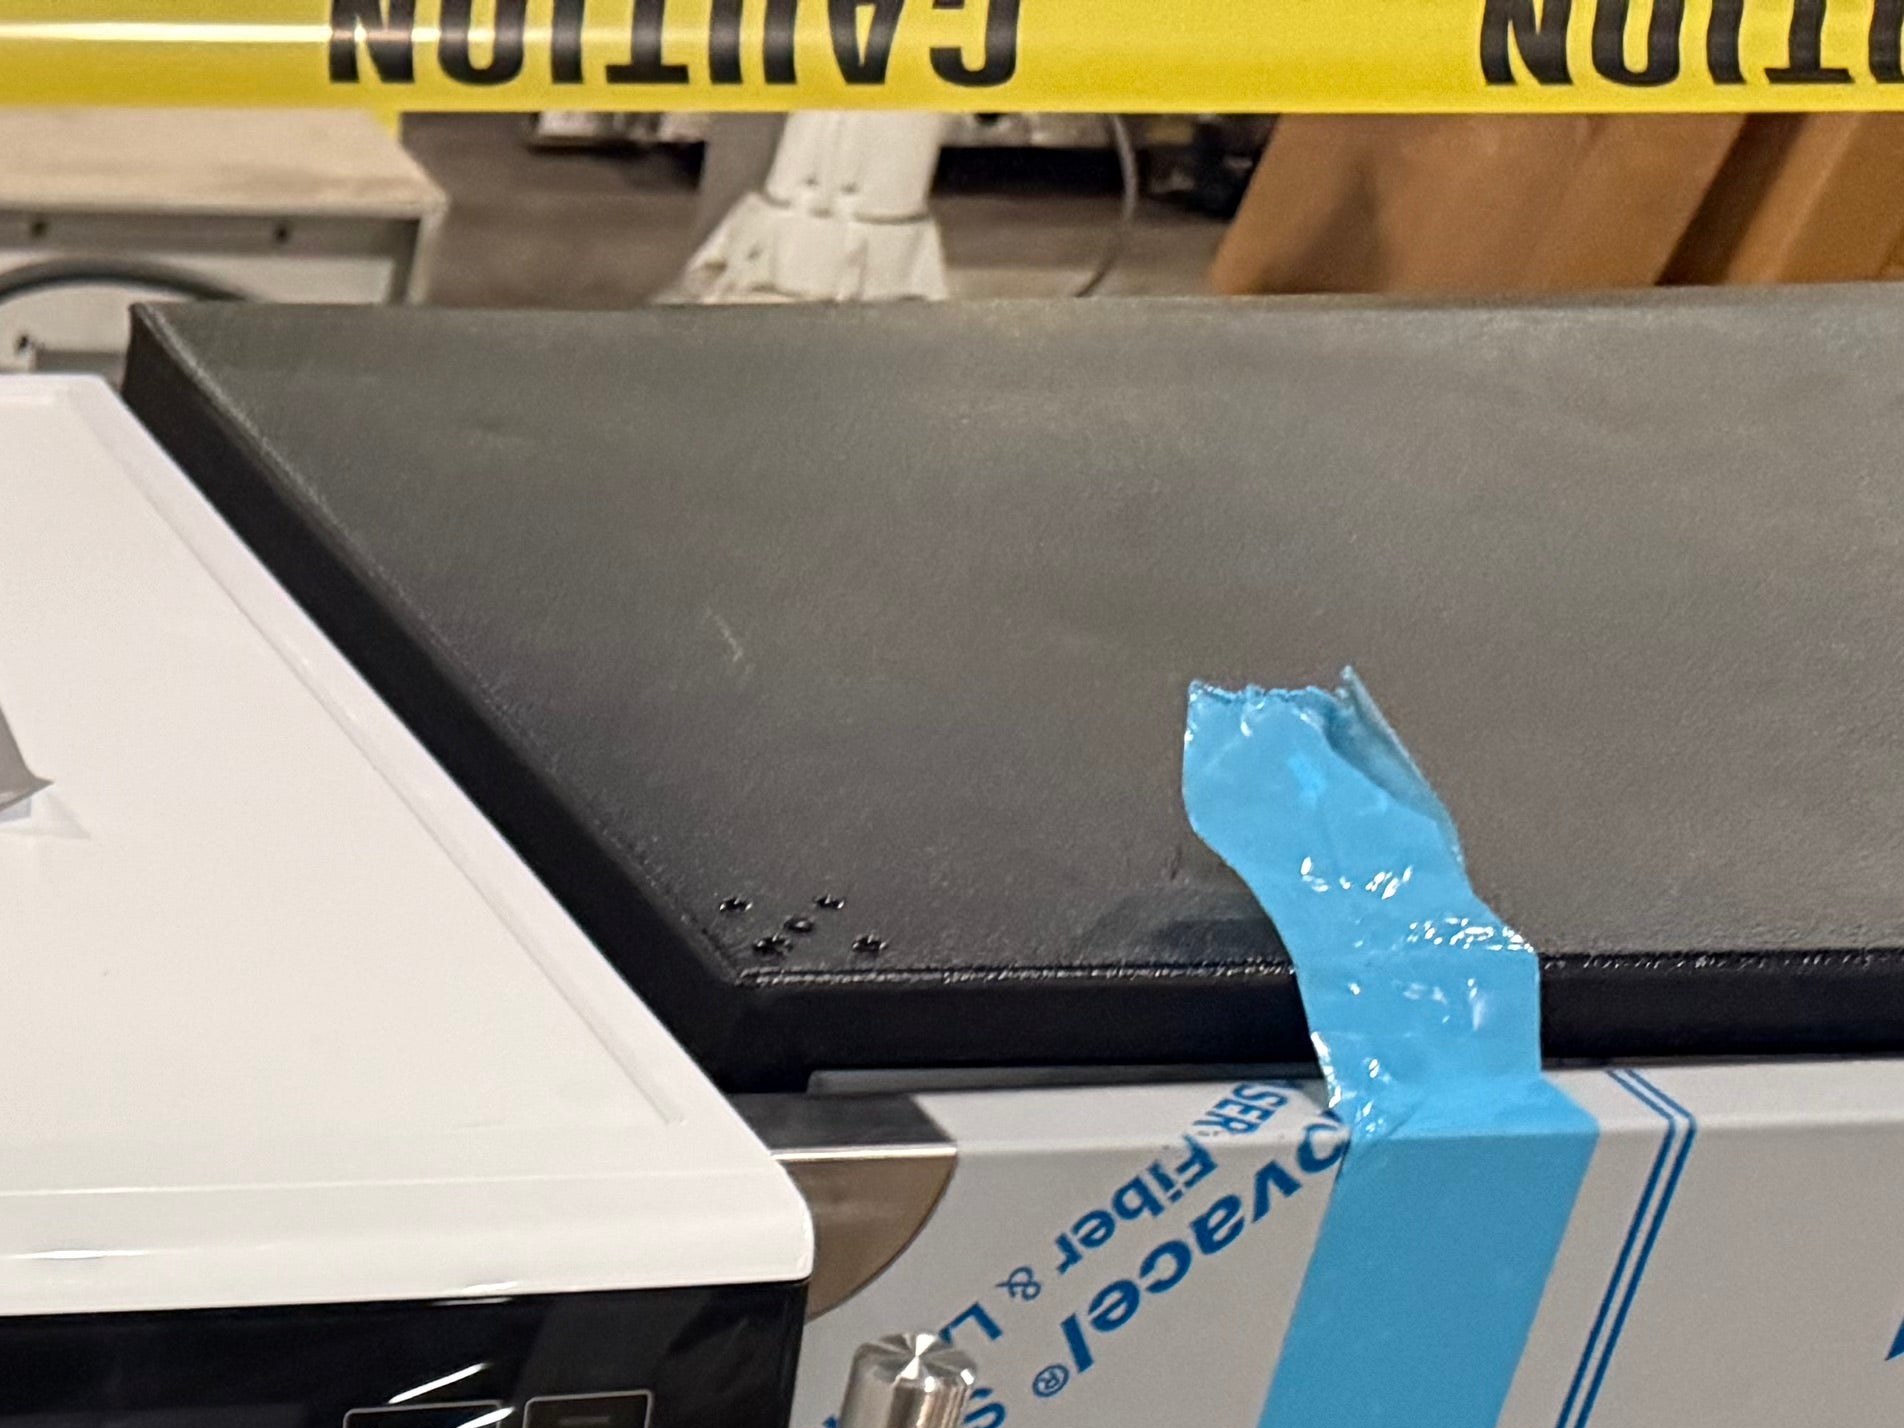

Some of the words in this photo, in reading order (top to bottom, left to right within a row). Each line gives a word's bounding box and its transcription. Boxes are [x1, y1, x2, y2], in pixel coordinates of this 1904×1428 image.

[1192, 1080, 1302, 1137] SER
[1056, 1136, 1220, 1274] Fiber
[995, 1266, 1043, 1301] &
[1033, 1112, 1352, 1398] ovacel®
